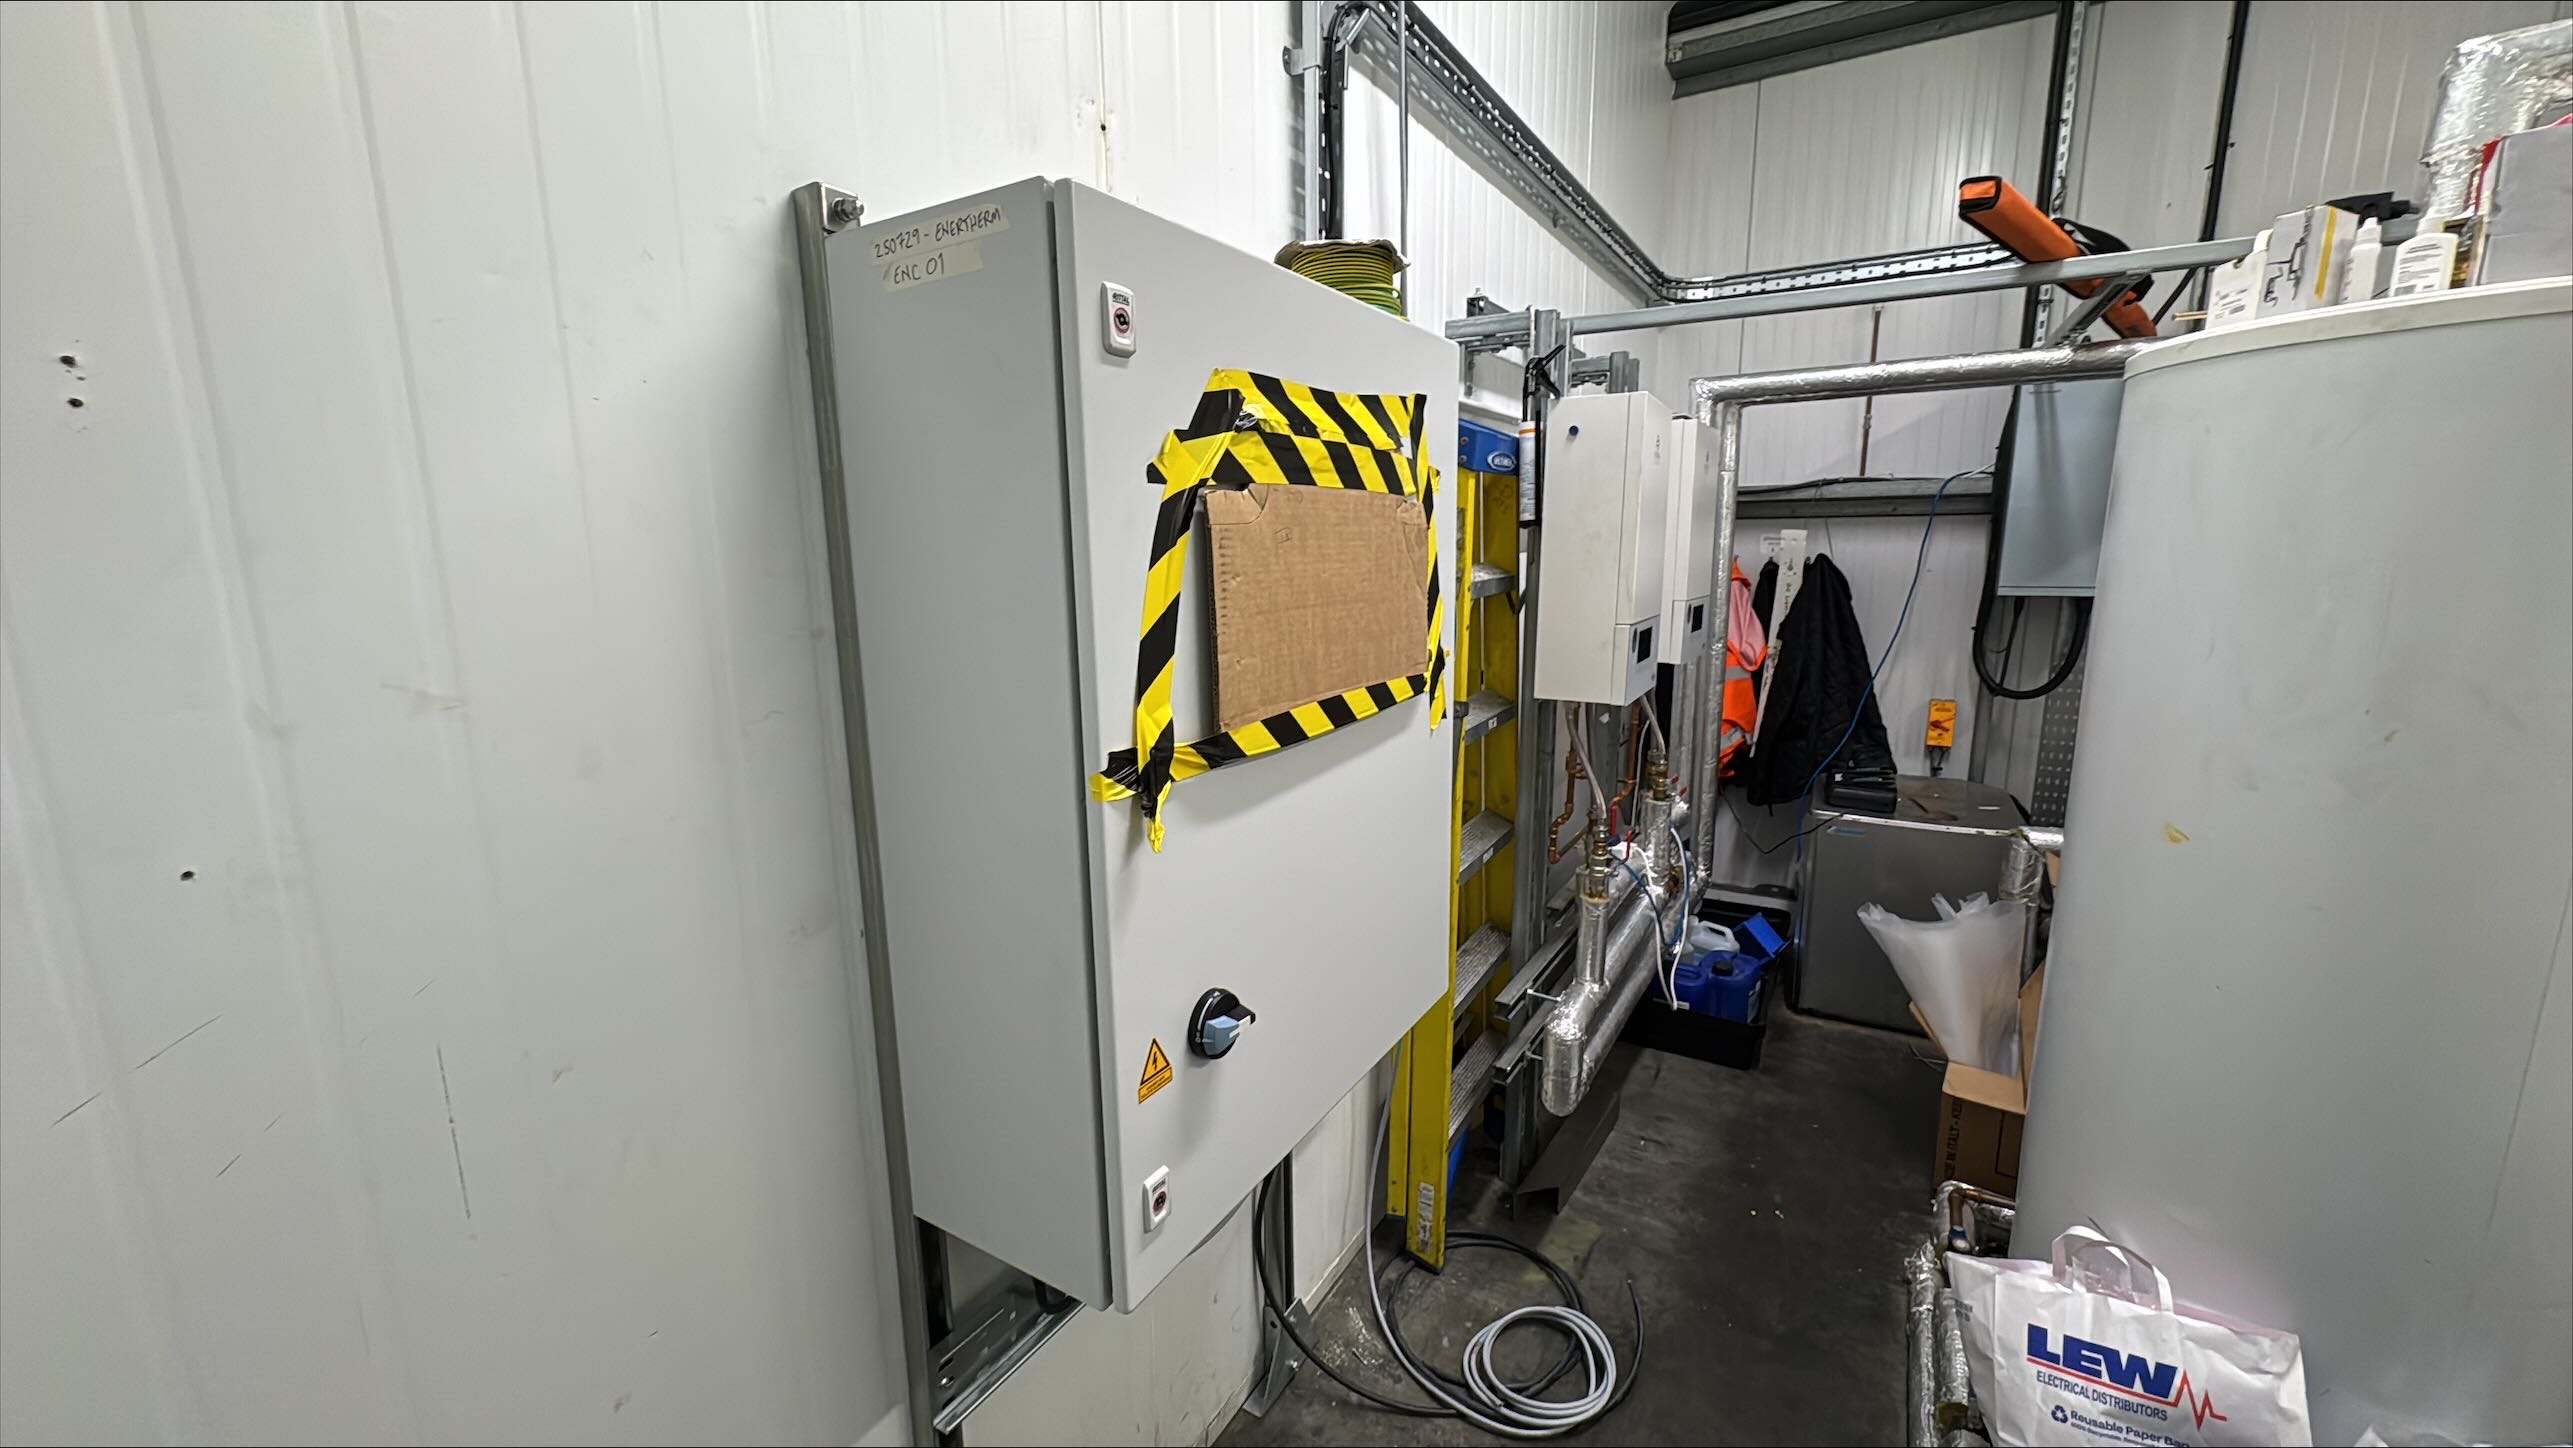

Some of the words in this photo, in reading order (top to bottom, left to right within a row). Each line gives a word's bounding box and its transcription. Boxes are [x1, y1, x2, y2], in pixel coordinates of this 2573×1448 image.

[874, 228, 921, 258] 250729
[935, 207, 1002, 242] ENERTHERM
[893, 263, 921, 284] ENC
[2027, 1322, 2178, 1399] LEW
[2036, 1370, 2090, 1401] ELECTRICAL
[2092, 1388, 2168, 1421] DISTRIBUTORS
[2070, 1410, 2124, 1433] Reusable
[2126, 1426, 2163, 1444] Paper
